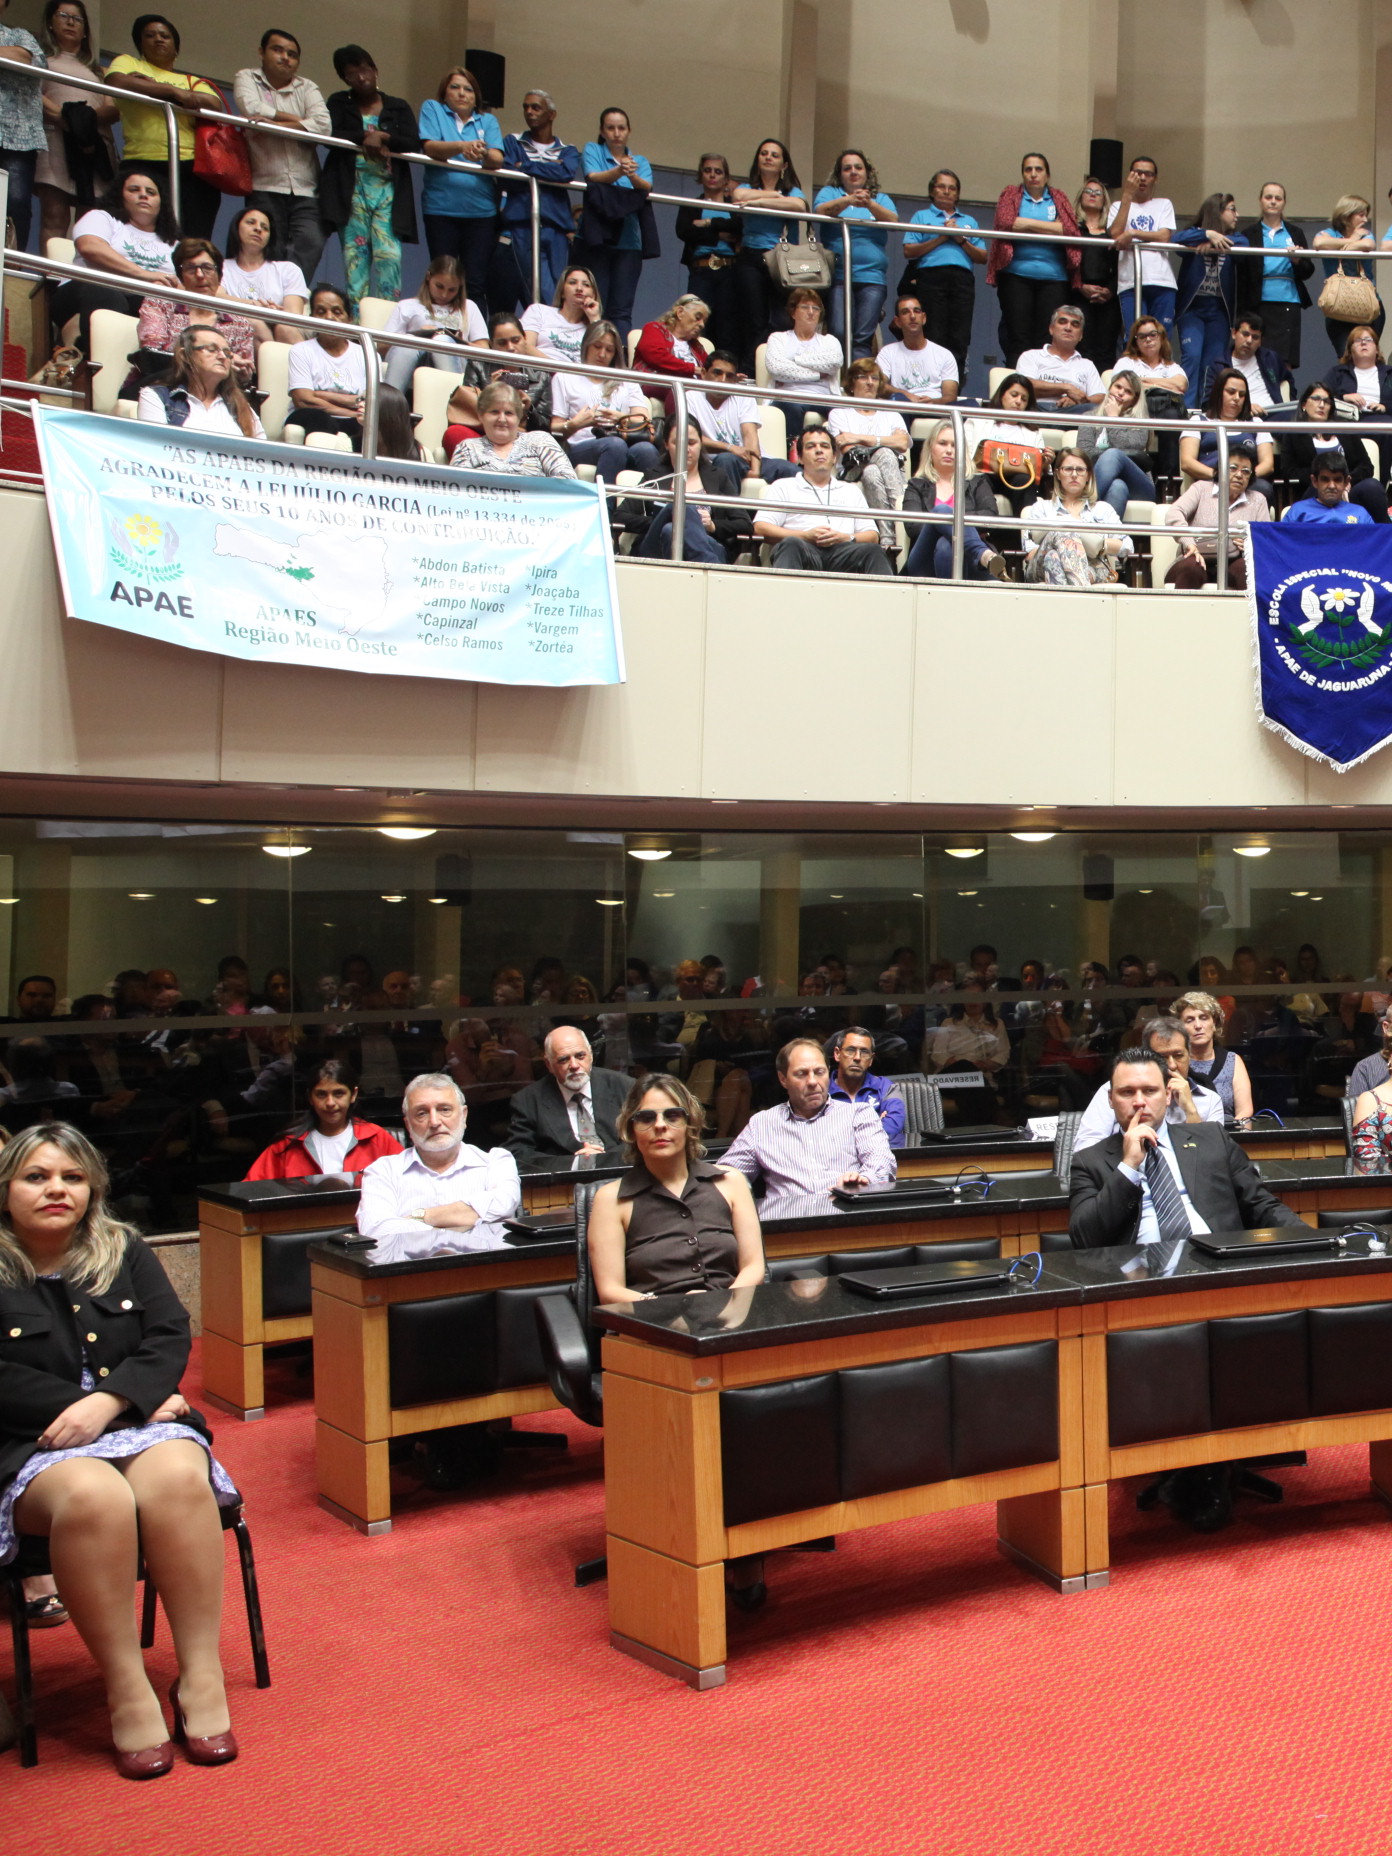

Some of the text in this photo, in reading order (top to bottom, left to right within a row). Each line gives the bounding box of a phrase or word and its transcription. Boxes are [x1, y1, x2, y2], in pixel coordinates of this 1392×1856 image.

[202, 451, 266, 474] APAES
[271, 459, 297, 476] DA
[304, 465, 375, 484] REGIÃO
[382, 473, 408, 488] DO
[414, 477, 460, 497] MEIO
[466, 483, 522, 503] OESTE
[100, 457, 232, 492] AGRADECEM
[239, 479, 250, 493] A
[257, 480, 286, 497] LEI
[292, 482, 346, 505] JÚLIO
[352, 492, 421, 516] GARCIA
[427, 504, 451, 518] (Lei
[521, 513, 536, 526] de
[151, 484, 216, 507] PELOS
[221, 496, 271, 516] SEUS
[277, 505, 299, 520] 10
[306, 508, 357, 527] ANOS
[363, 515, 387, 531] DE
[419, 557, 505, 576] Abdon Batista
[531, 565, 558, 580] Ipira
[420, 577, 445, 589] Alto
[481, 580, 510, 594] Vista
[531, 584, 580, 601] Joaçaba
[110, 580, 194, 619] APAE
[470, 598, 505, 613] Novos
[1268, 584, 1288, 626] ESCOLA
[1284, 568, 1340, 587] ESPECIAL
[256, 605, 317, 628] APAES
[533, 602, 604, 618] Treze Tilhas
[423, 612, 478, 631] Capinzal
[534, 622, 579, 638] Vargem
[224, 620, 398, 657] Região Meio Oeste
[424, 632, 504, 651] Celso Ramos
[535, 640, 573, 654] Zortéa
[1275, 645, 1302, 674] APAE
[1299, 670, 1317, 686] DE
[1317, 665, 1392, 692] JAGUARUNA
